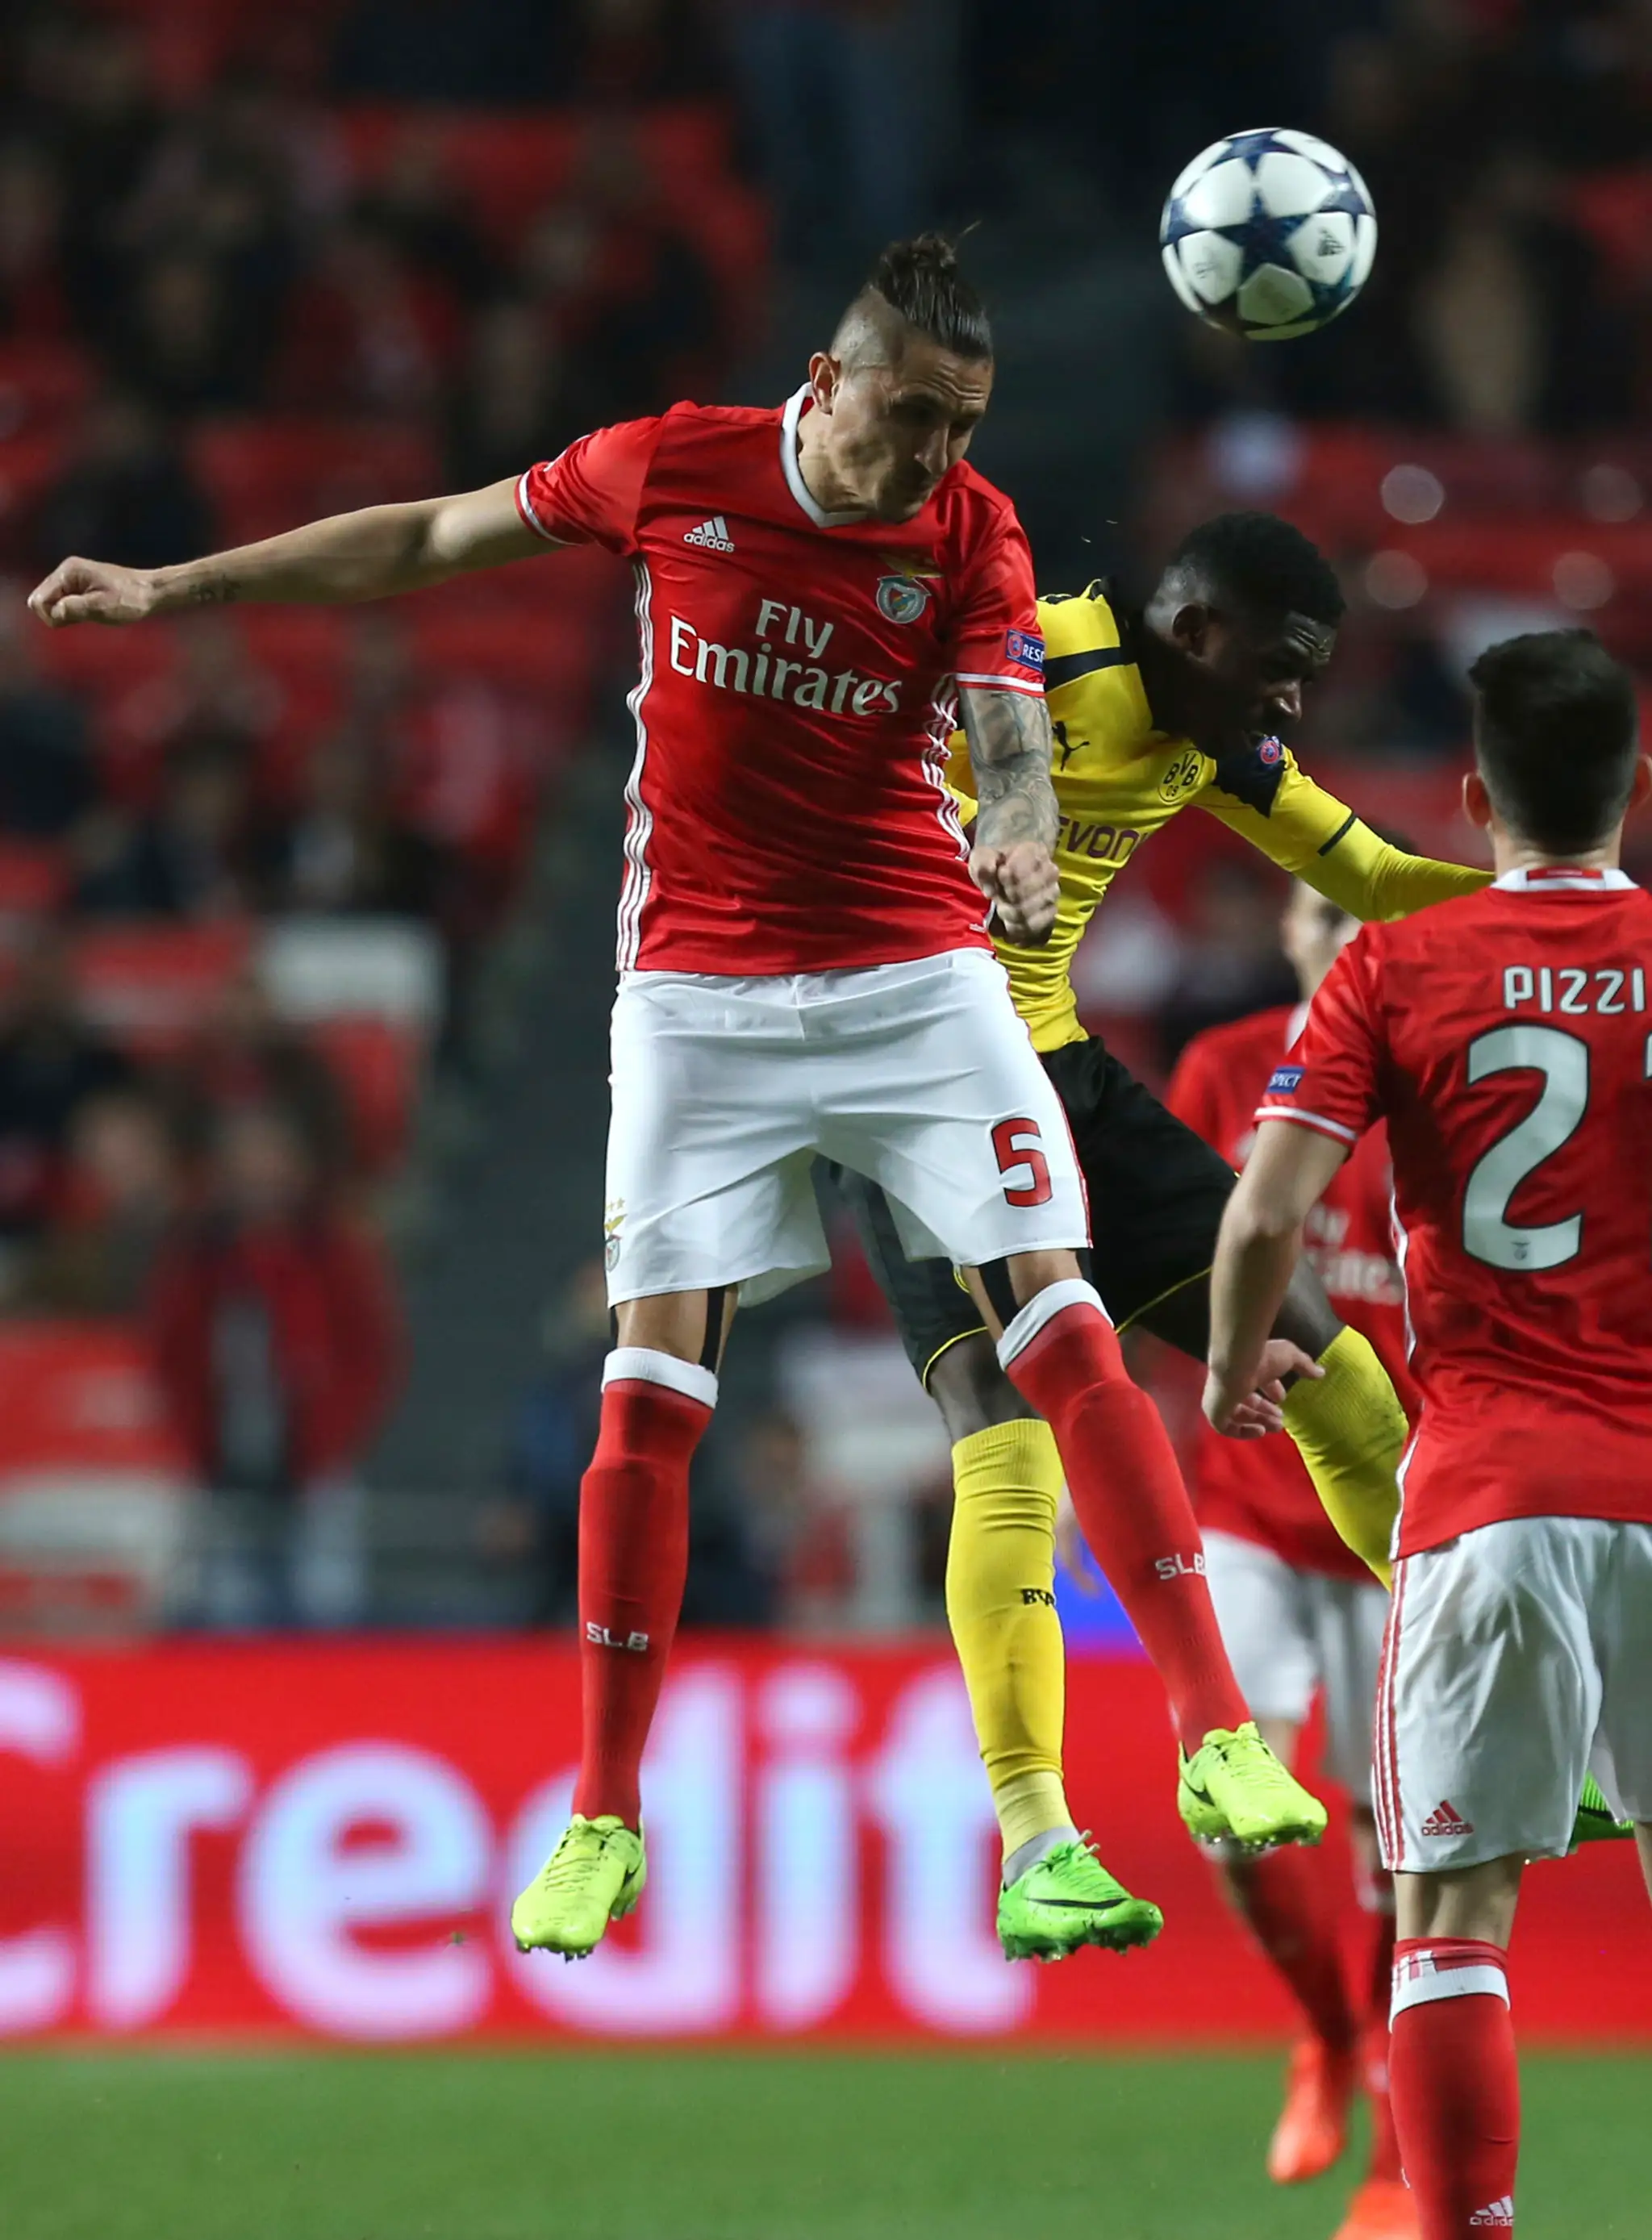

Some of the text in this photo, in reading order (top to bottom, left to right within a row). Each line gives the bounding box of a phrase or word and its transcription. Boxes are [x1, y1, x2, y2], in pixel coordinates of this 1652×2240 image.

[684, 533, 735, 553] adidas
[755, 599, 834, 659] Fly
[670, 615, 902, 716] Emirates
[1163, 753, 1199, 786] BVB
[1504, 965, 1646, 1015] PIZZI
[991, 1117, 1053, 1208] 5
[1462, 1023, 1652, 1273] 2
[1155, 1552, 1205, 1580] SLB
[586, 1621, 649, 1652] SLB
